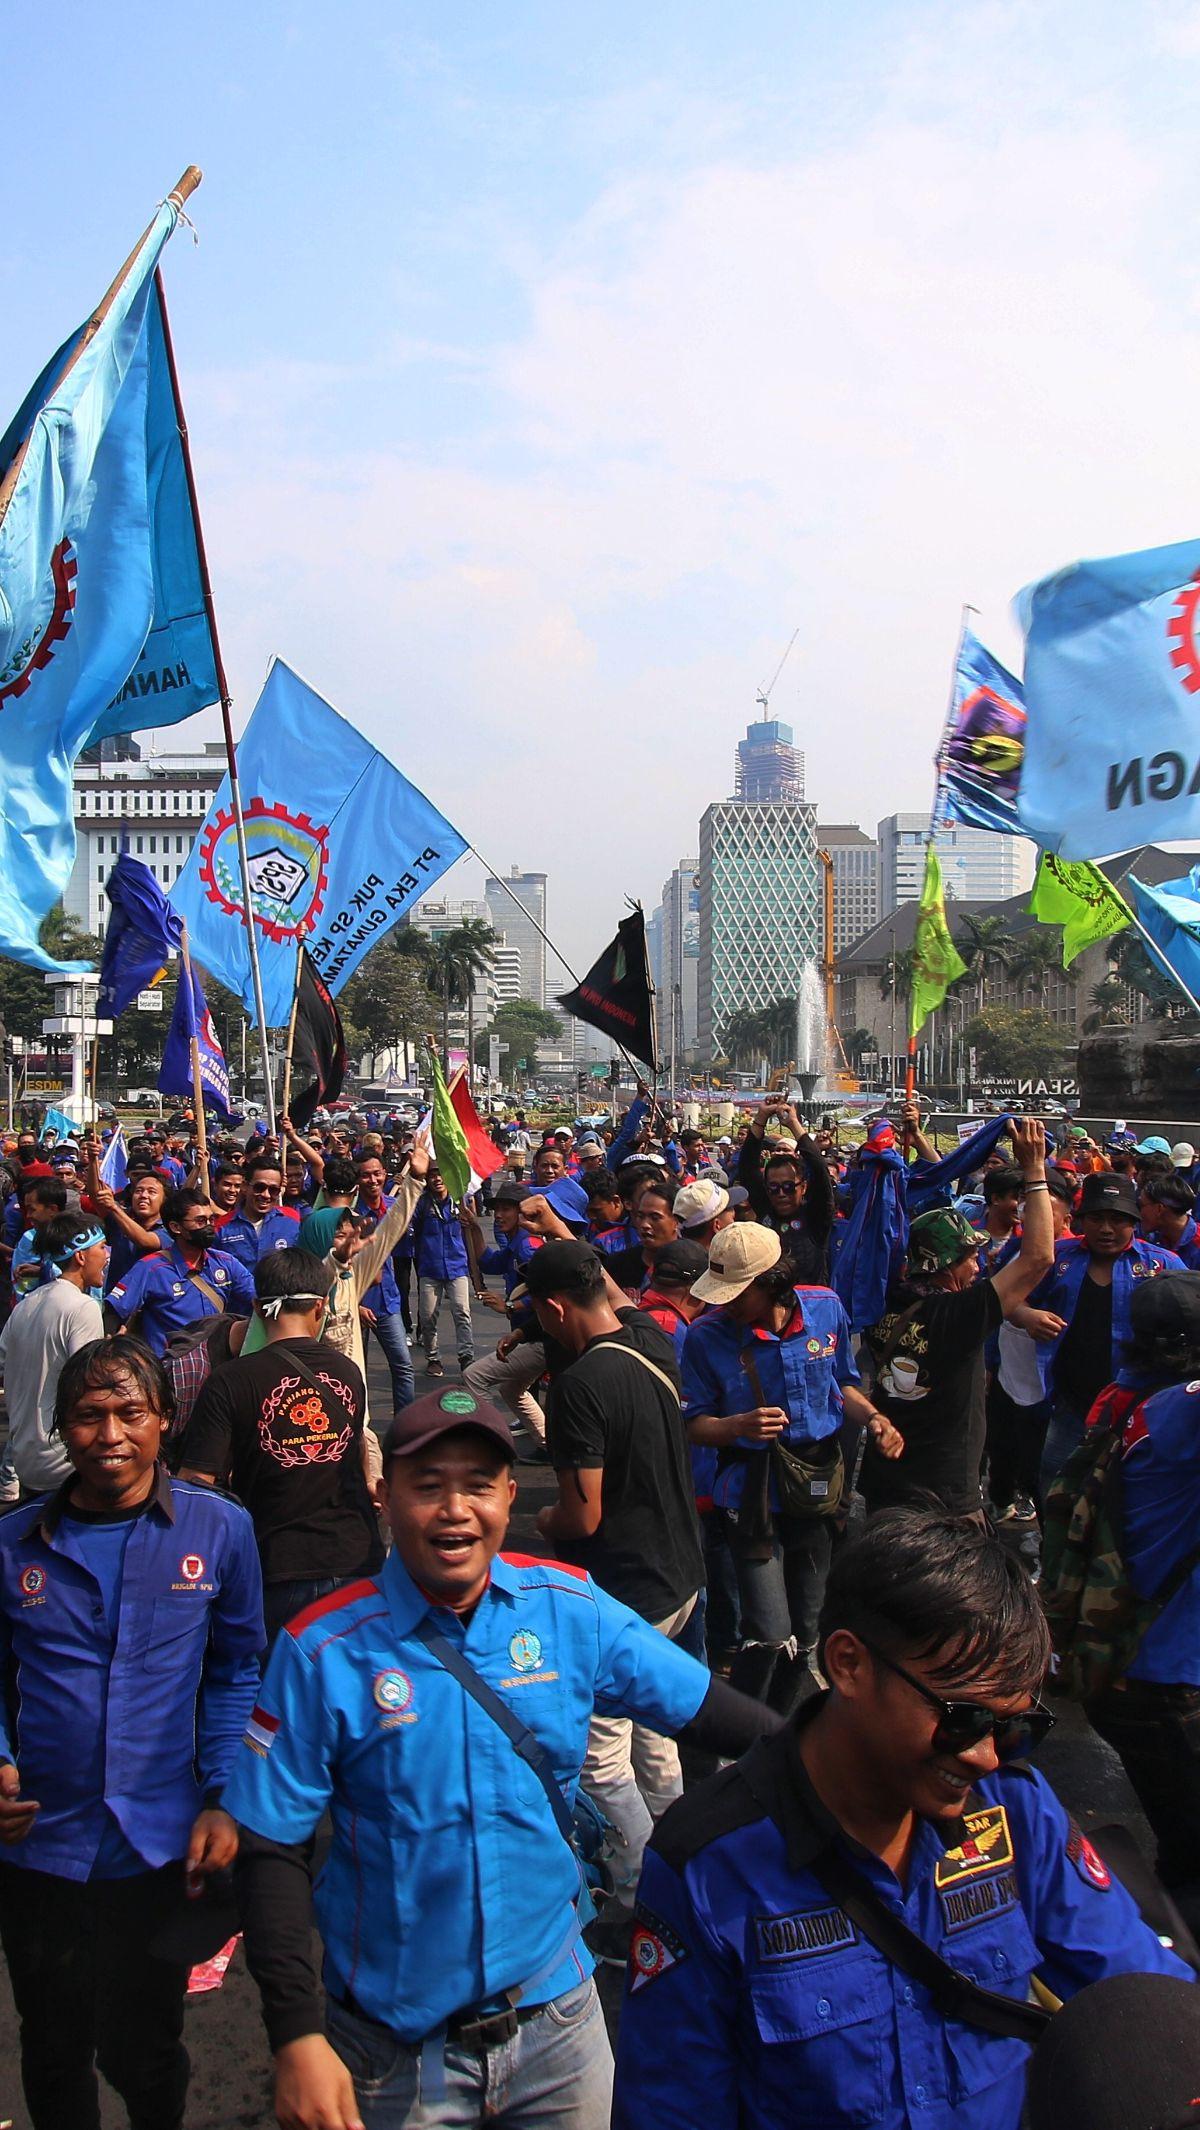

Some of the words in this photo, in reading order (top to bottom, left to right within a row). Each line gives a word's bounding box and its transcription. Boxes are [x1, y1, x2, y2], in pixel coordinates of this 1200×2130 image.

[27, 1080, 62, 1090] ESDM
[282, 1437, 305, 1446] PARA
[306, 1432, 339, 1442] PEKERJA
